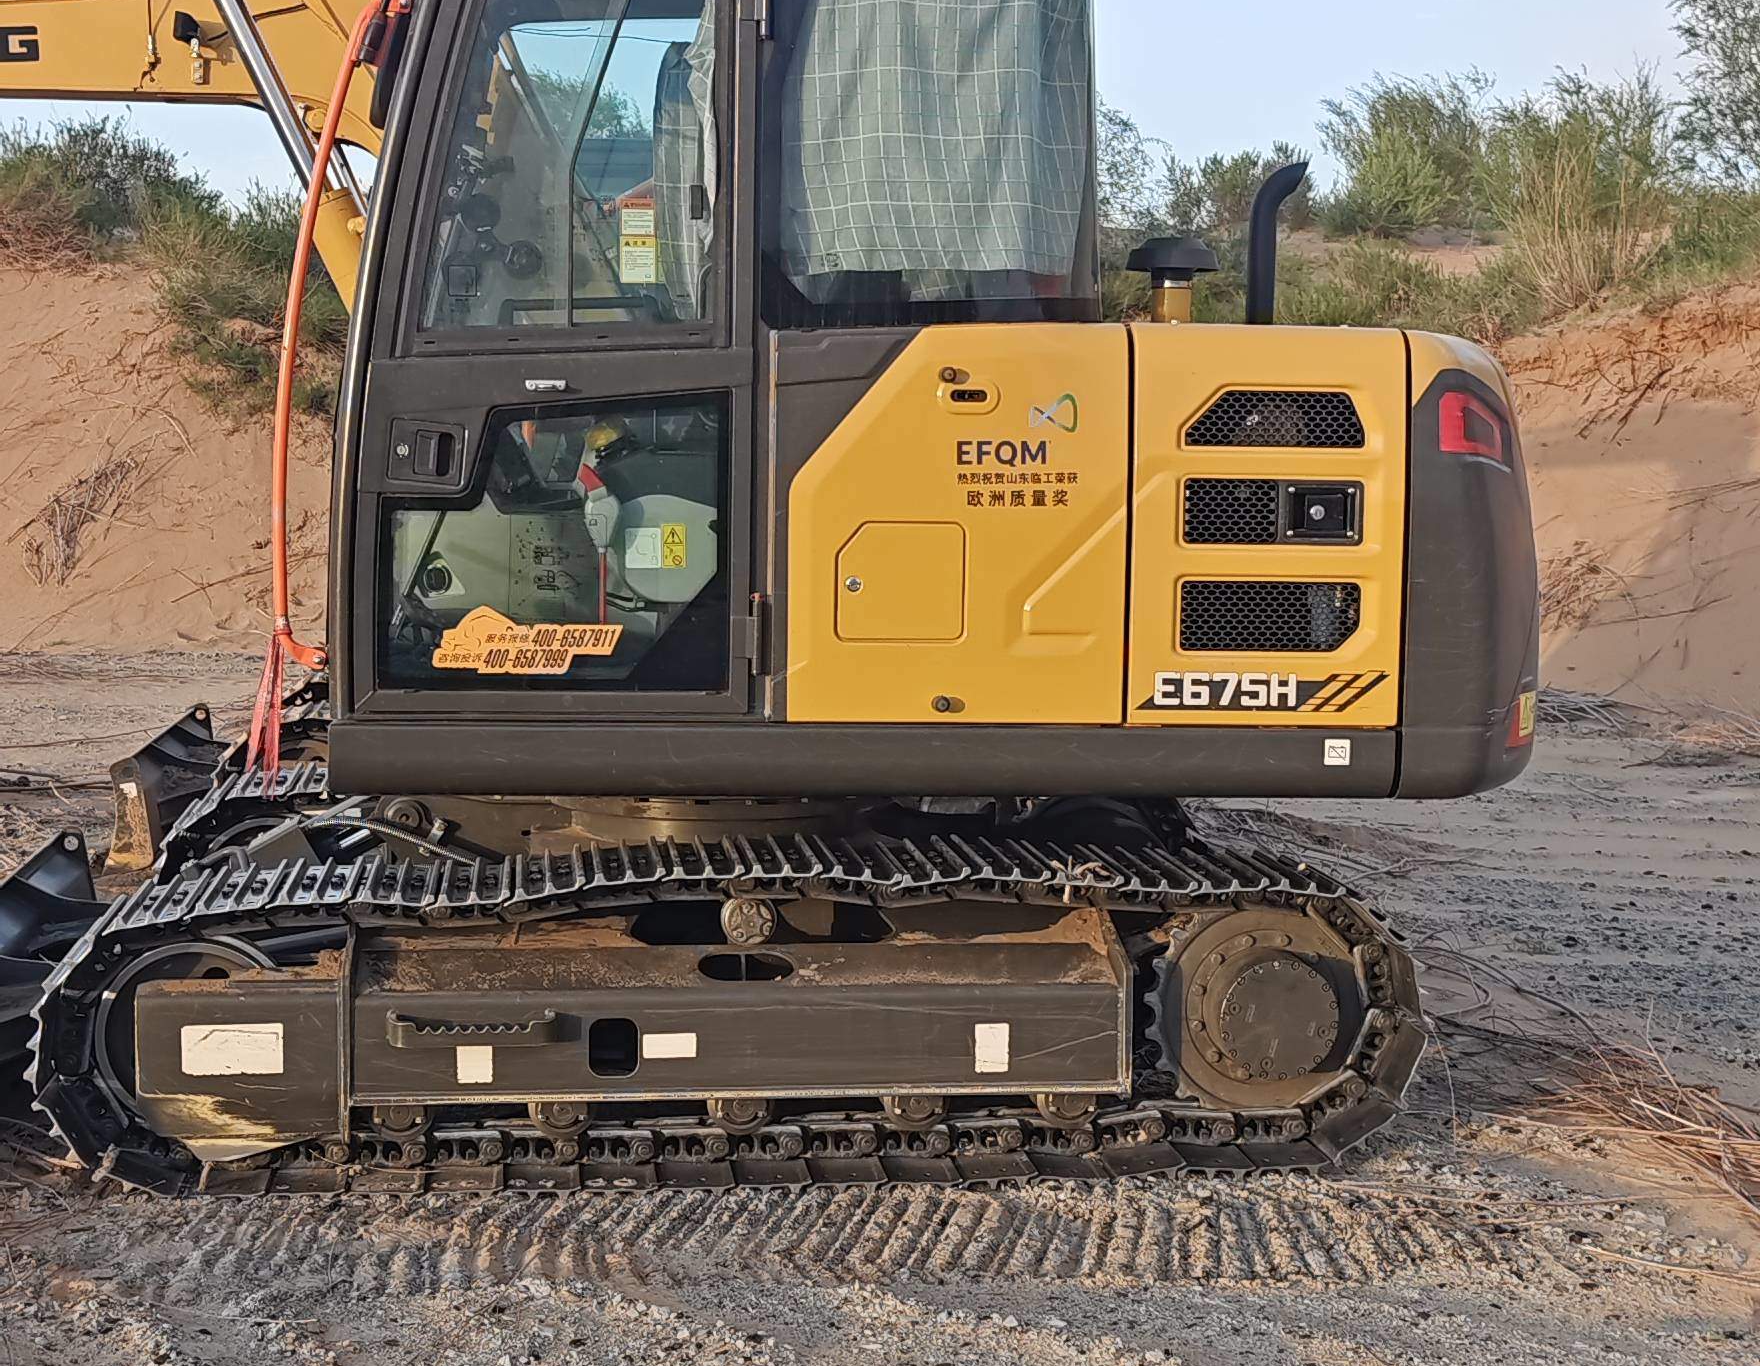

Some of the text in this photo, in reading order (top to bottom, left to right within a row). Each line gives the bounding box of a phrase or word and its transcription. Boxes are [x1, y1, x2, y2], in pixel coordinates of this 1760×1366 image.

[957, 440, 1047, 467] EFQM
[957, 472, 1079, 485] 热烈祝贺山东临工荣获
[966, 489, 1069, 507] 欧洲质量奖
[532, 628, 617, 648] 400-6587911
[483, 648, 569, 669] 400-6587999
[1153, 671, 1297, 706] E675H
